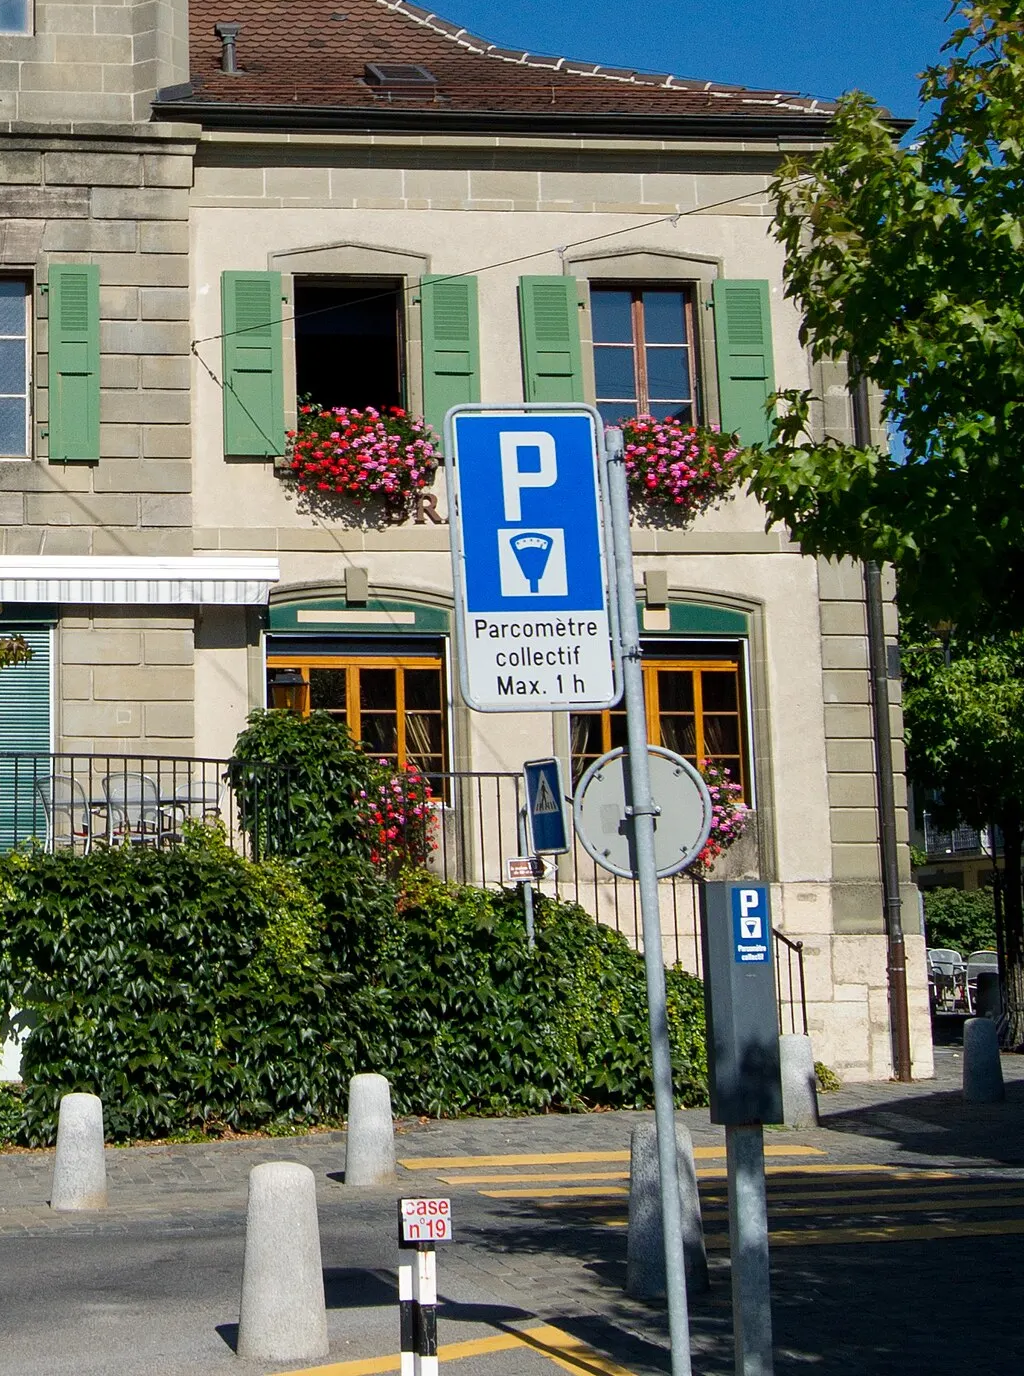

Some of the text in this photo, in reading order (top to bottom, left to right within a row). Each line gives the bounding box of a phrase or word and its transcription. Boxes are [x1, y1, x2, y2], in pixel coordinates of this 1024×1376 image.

[499, 431, 558, 522] P
[474, 617, 598, 639] Parcomètre
[496, 645, 581, 667] collectif
[497, 674, 585, 696] Max. 1 h
[739, 889, 759, 917] P
[406, 1200, 449, 1216] case
